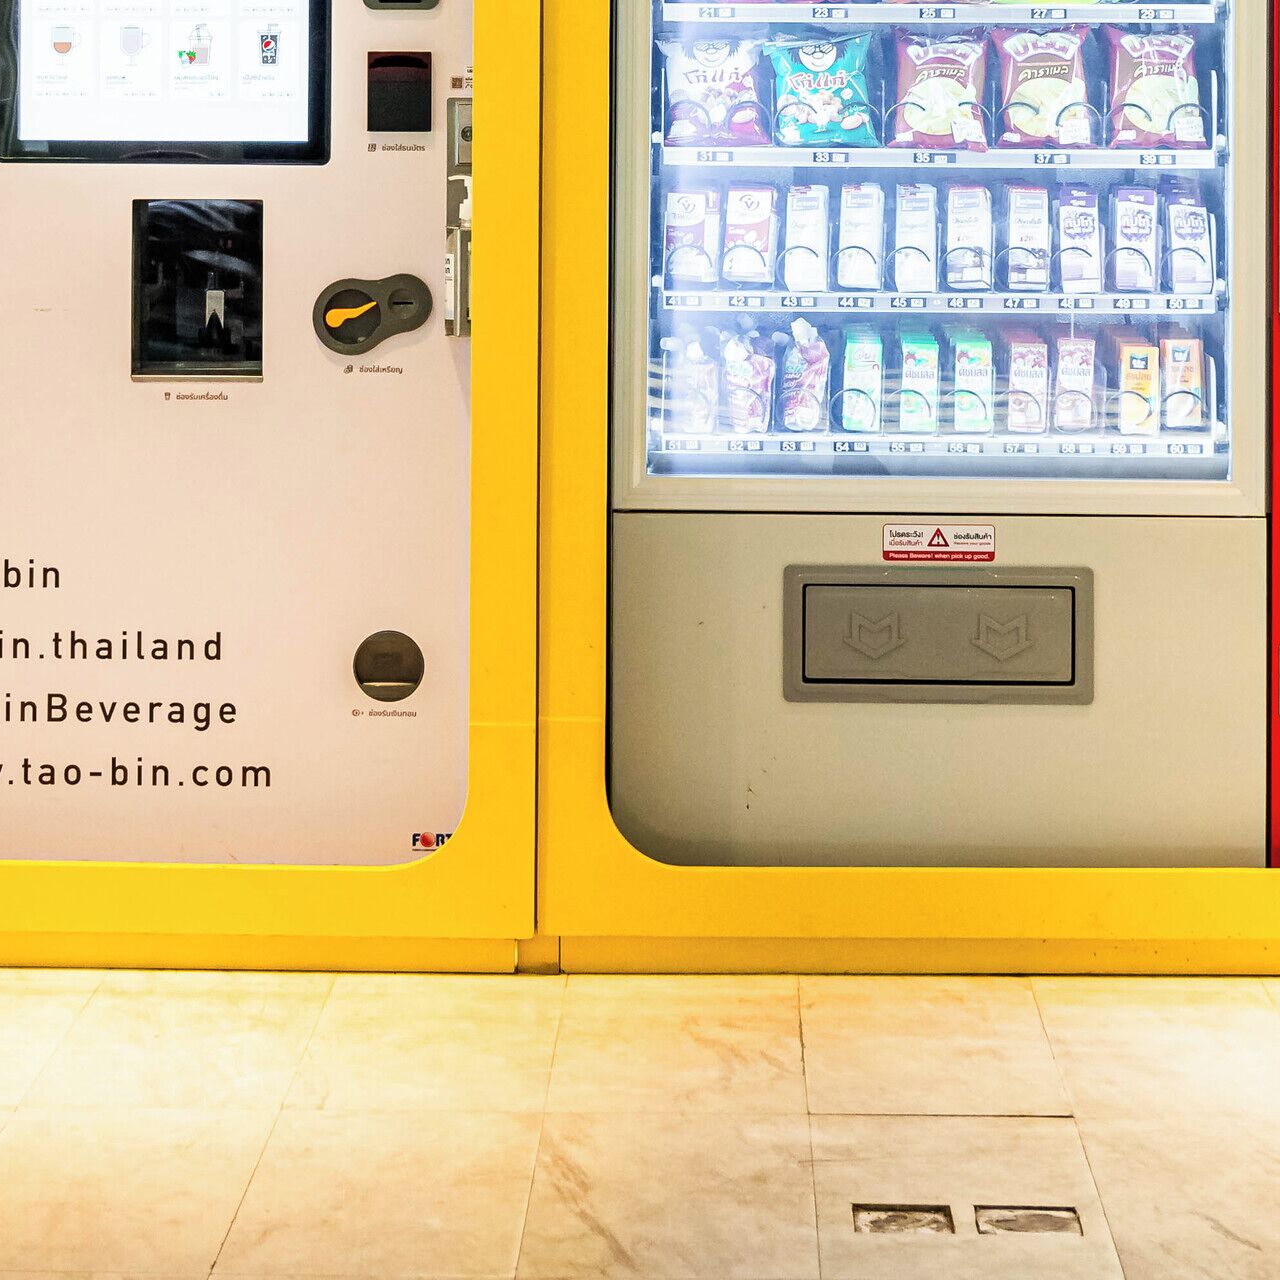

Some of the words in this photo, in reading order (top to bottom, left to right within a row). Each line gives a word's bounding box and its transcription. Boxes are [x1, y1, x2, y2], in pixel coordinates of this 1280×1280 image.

[814, 8, 828, 19] 23
[921, 8, 936, 19] 25
[1033, 8, 1048, 19] 27
[1019, 65, 1070, 82] คาราเมล
[815, 152, 829, 163] 33
[916, 152, 930, 163] 35
[1036, 152, 1050, 163] 37
[1142, 152, 1156, 163] 39
[839, 297, 854, 308] 44
[1005, 297, 1019, 308] 47
[368, 709, 417, 717] ช่องรับเงินทอน
